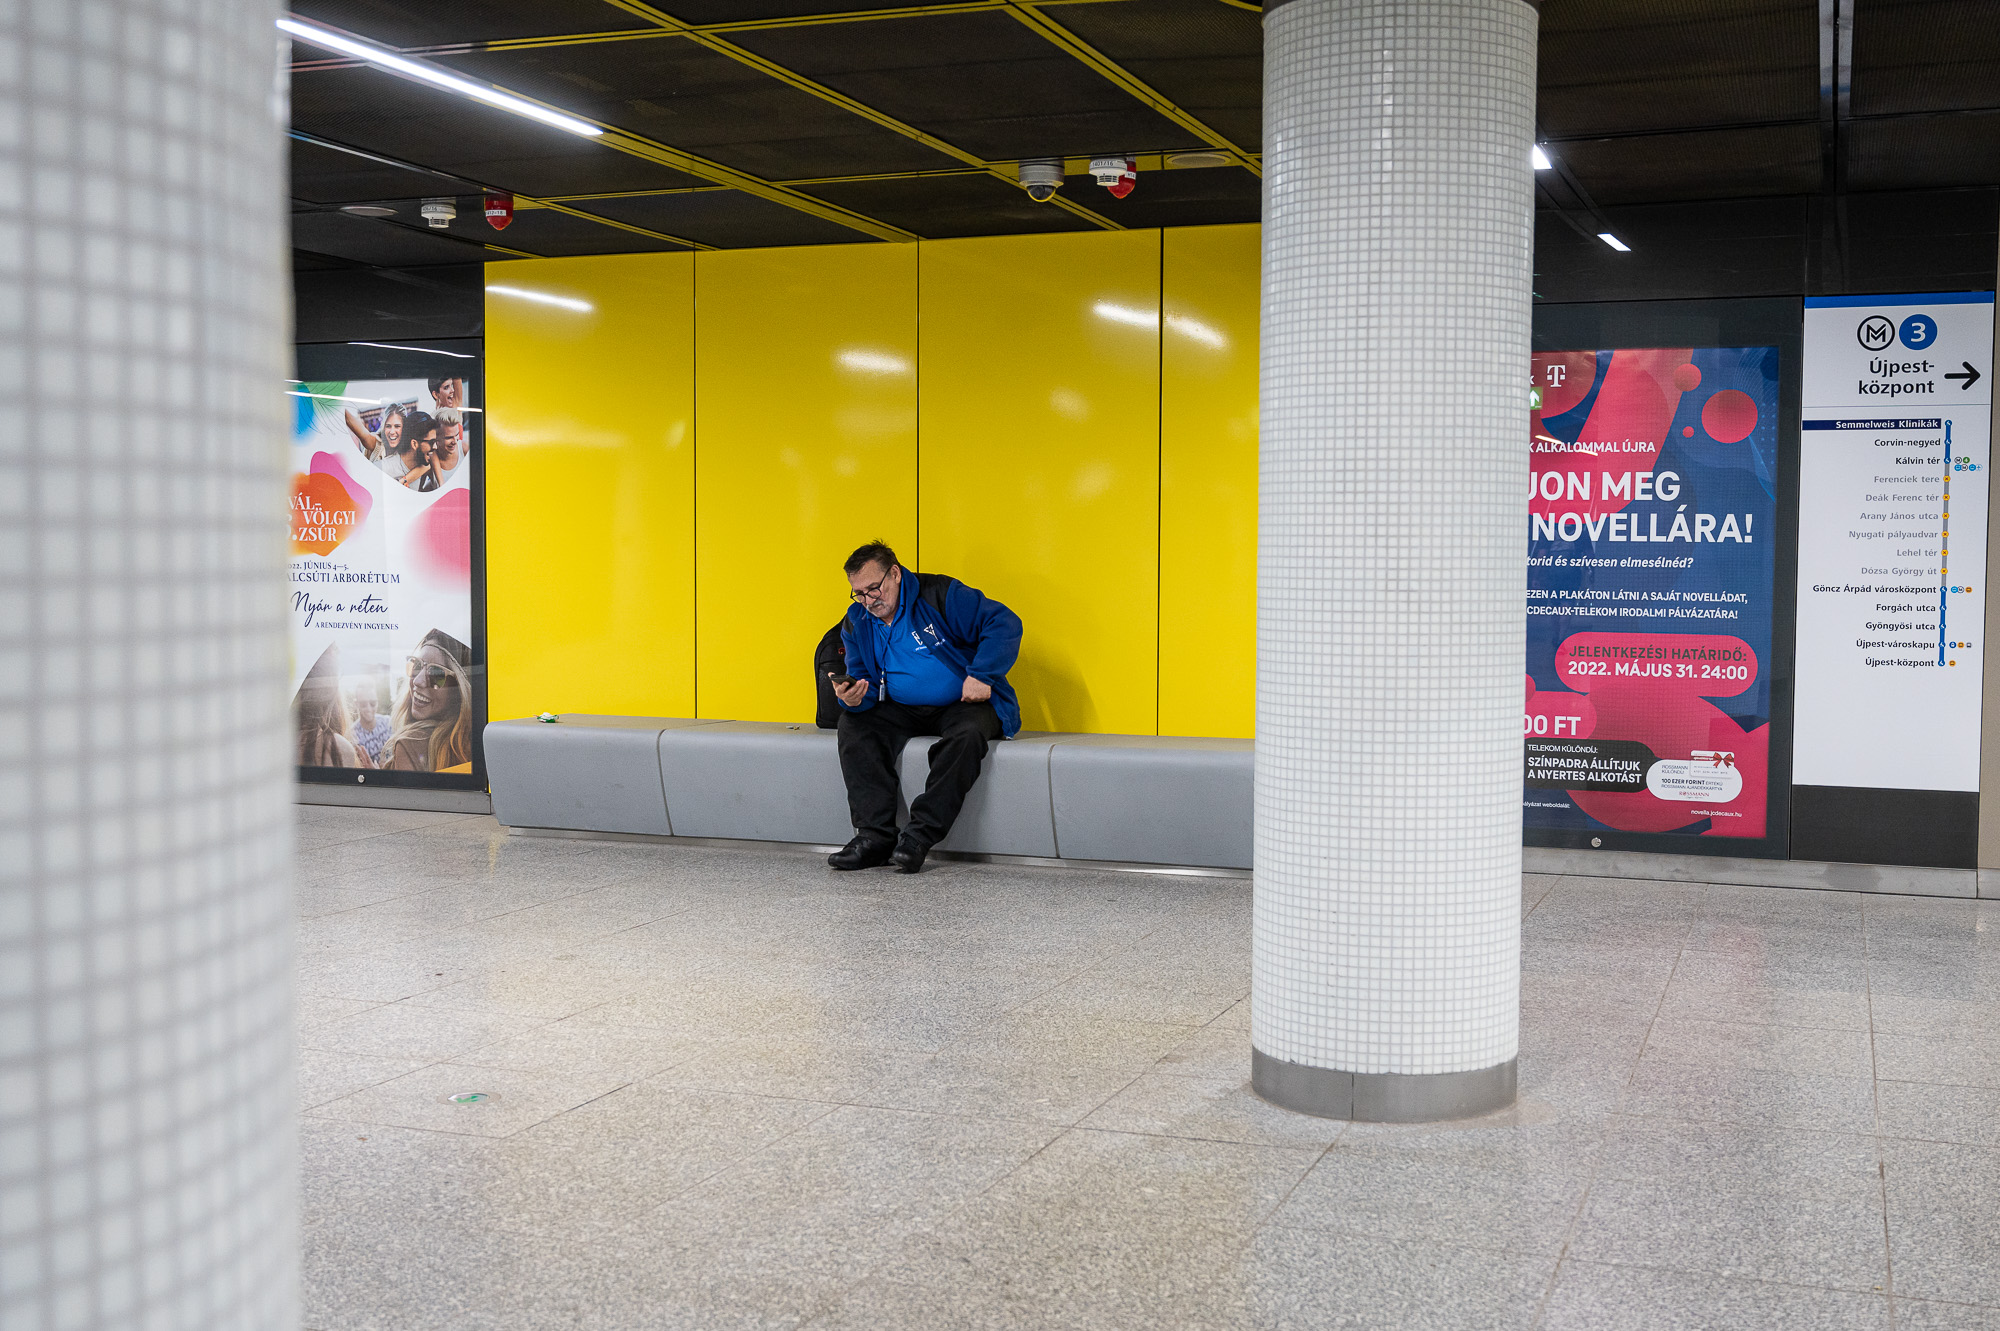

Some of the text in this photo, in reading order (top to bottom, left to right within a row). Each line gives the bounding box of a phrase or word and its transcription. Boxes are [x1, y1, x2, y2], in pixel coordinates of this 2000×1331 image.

[1910, 322, 1926, 342] 3
[1869, 357, 1935, 377] Újpest-
[1546, 364, 1566, 388] T
[1858, 380, 1934, 398] központ
[1835, 420, 1938, 429] Semmelweis Klinikák
[1535, 441, 1620, 453] ALKALOMMAL
[1622, 439, 1656, 453] ÚJRA
[1874, 438, 1941, 448] Corvin-negyed
[1895, 456, 1941, 465] Kálvin tér
[1874, 475, 1940, 484] Ferenciek tere
[1601, 470, 1681, 502] MEG
[1865, 494, 1939, 502] Deák Ferenc tér
[303, 507, 356, 526] VÖLGYI
[1860, 512, 1887, 522] Arany
[1889, 512, 1916, 521] János
[1532, 504, 1753, 543] NOVELLÁRA!
[298, 523, 337, 541] ZSÚR
[1849, 530, 1939, 540] Nyugati pályaudvar
[1896, 549, 1938, 557] Lehel tér
[303, 559, 332, 570] JÚNIUS
[1554, 556, 1568, 568] és
[1569, 557, 1618, 568] szívesen
[1620, 556, 1694, 569] elmesélnéd?
[332, 571, 400, 584] ARBORÉTUM
[1861, 567, 1937, 576] Dózsa György út
[1812, 583, 1937, 594] Göncz Árpád városközpont
[1550, 590, 1557, 599] A
[1559, 588, 1610, 600] PLAKÁTON
[1612, 588, 1640, 601] LÁTNI
[1641, 592, 1649, 601] A
[1650, 589, 1681, 602] SAJÁT
[1682, 590, 1748, 604] NOVELLÁDAT,
[290, 590, 389, 628] Nyár a réten
[1619, 607, 1666, 618] IRODALMI
[1668, 607, 1738, 619] PÁLYÁZATÁRA!
[1876, 603, 1913, 613] Forgách
[321, 620, 363, 630] RENDEZVÉNY
[364, 622, 399, 630] INGYENES
[1865, 621, 1936, 631] Gyöngyösi utca
[1856, 638, 1935, 649] Újpest-városkapu
[1569, 644, 1748, 662] JELENTKEZÉSI HATÁRIDŐ:
[1865, 656, 1935, 667] Újpest-központ
[1568, 659, 1748, 680] 2022. MÁJUS 31. 24:00
[1554, 716, 1581, 736] FT
[1527, 744, 1598, 754] TELEKOM KÜLÖNDÍJ:
[1527, 756, 1641, 771] SZÍNPADRA ÁLLÍTJUK
[1527, 770, 1642, 783] A NYERTES ALKOTÁST
